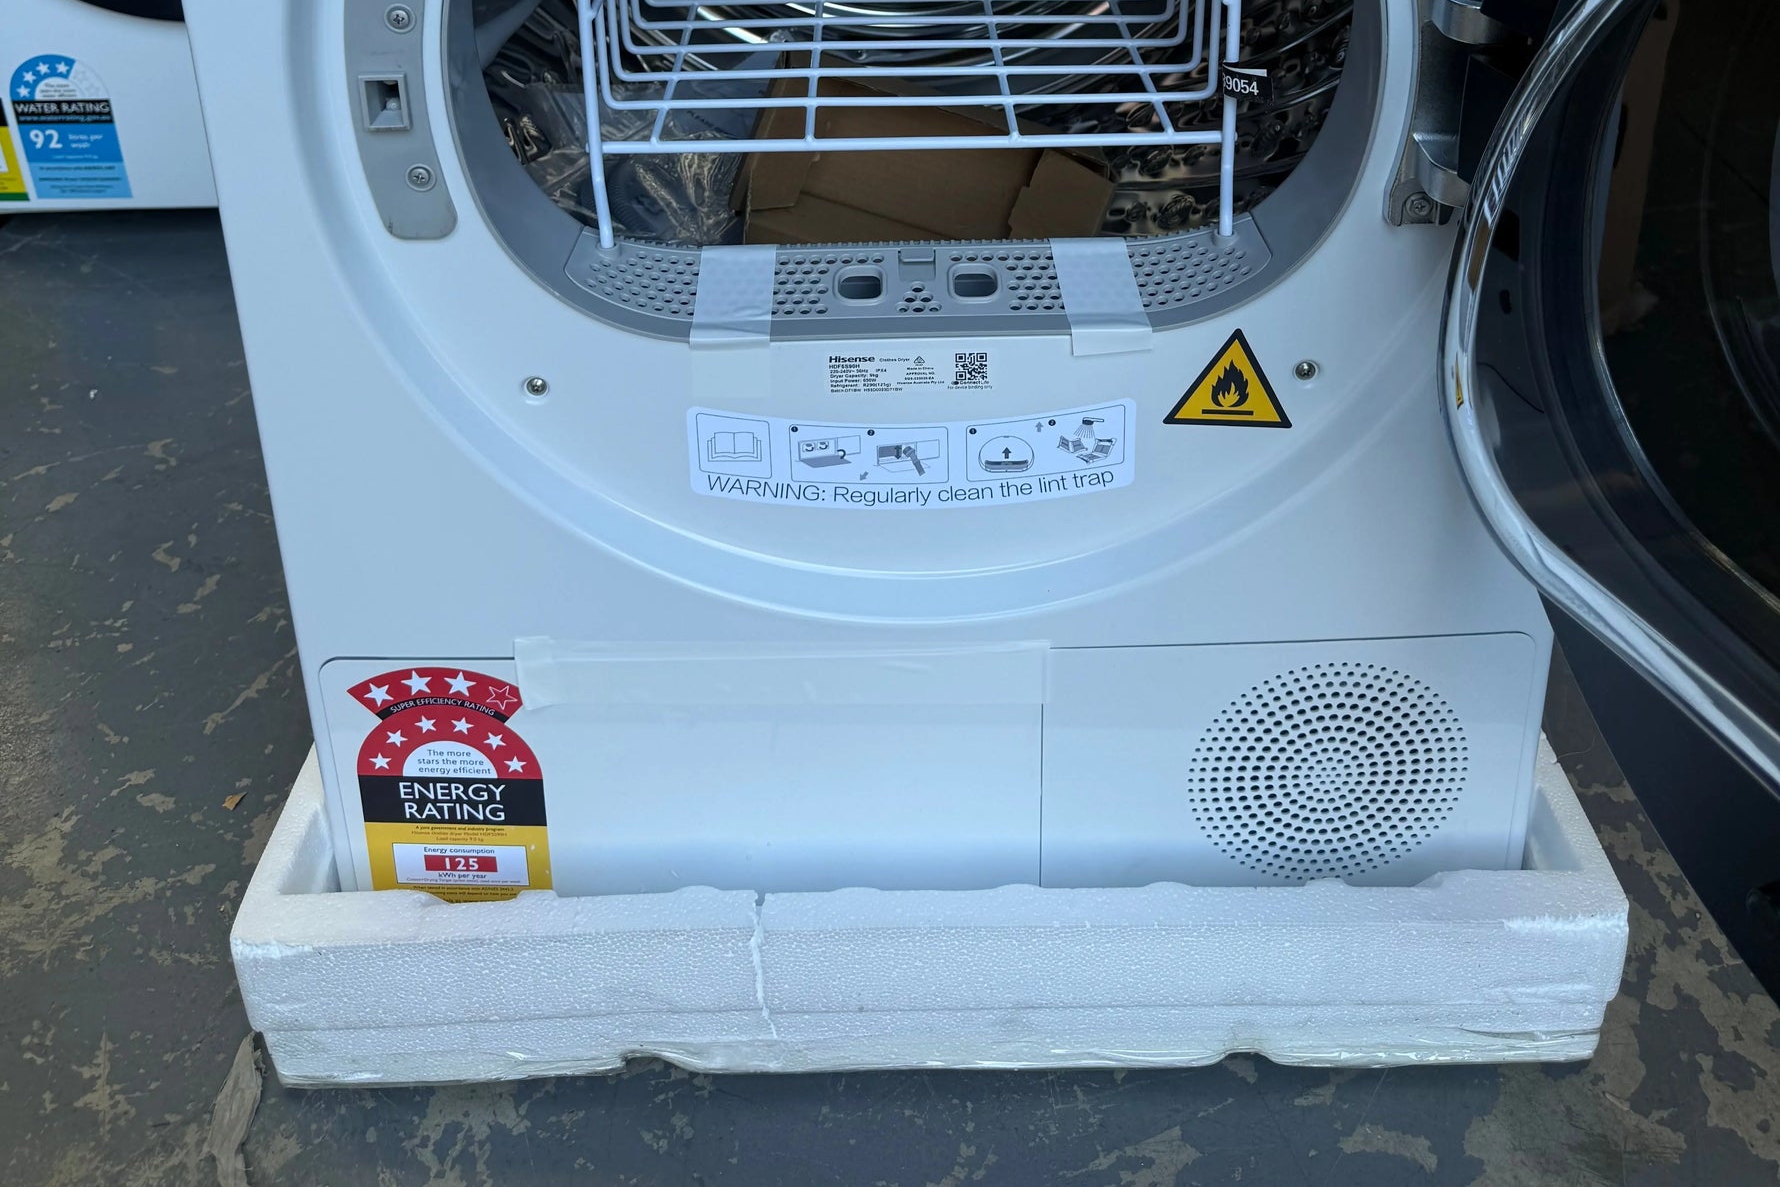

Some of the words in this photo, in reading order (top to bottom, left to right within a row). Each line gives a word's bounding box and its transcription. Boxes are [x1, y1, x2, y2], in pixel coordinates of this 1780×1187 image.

[14, 102, 59, 114] WATER
[61, 101, 110, 114] RATING
[29, 129, 63, 149] 92
[829, 355, 875, 364] Hisense
[707, 474, 826, 502] WARNING:
[833, 485, 931, 507] Regularly
[938, 485, 993, 502] clean
[1000, 478, 1033, 498] the
[1038, 474, 1068, 494] lint
[1072, 469, 1114, 489] trap
[390, 700, 416, 713] SUPER
[416, 697, 462, 706] EFFICIENCY
[464, 700, 495, 716] RATING
[427, 749, 445, 757] The
[418, 767, 451, 775] energy
[453, 766, 491, 775] efficient
[399, 781, 506, 801] ENERGY
[404, 802, 506, 821] RATING
[423, 846, 448, 854] Energy
[449, 847, 495, 855] consumption
[445, 857, 479, 870] 125
